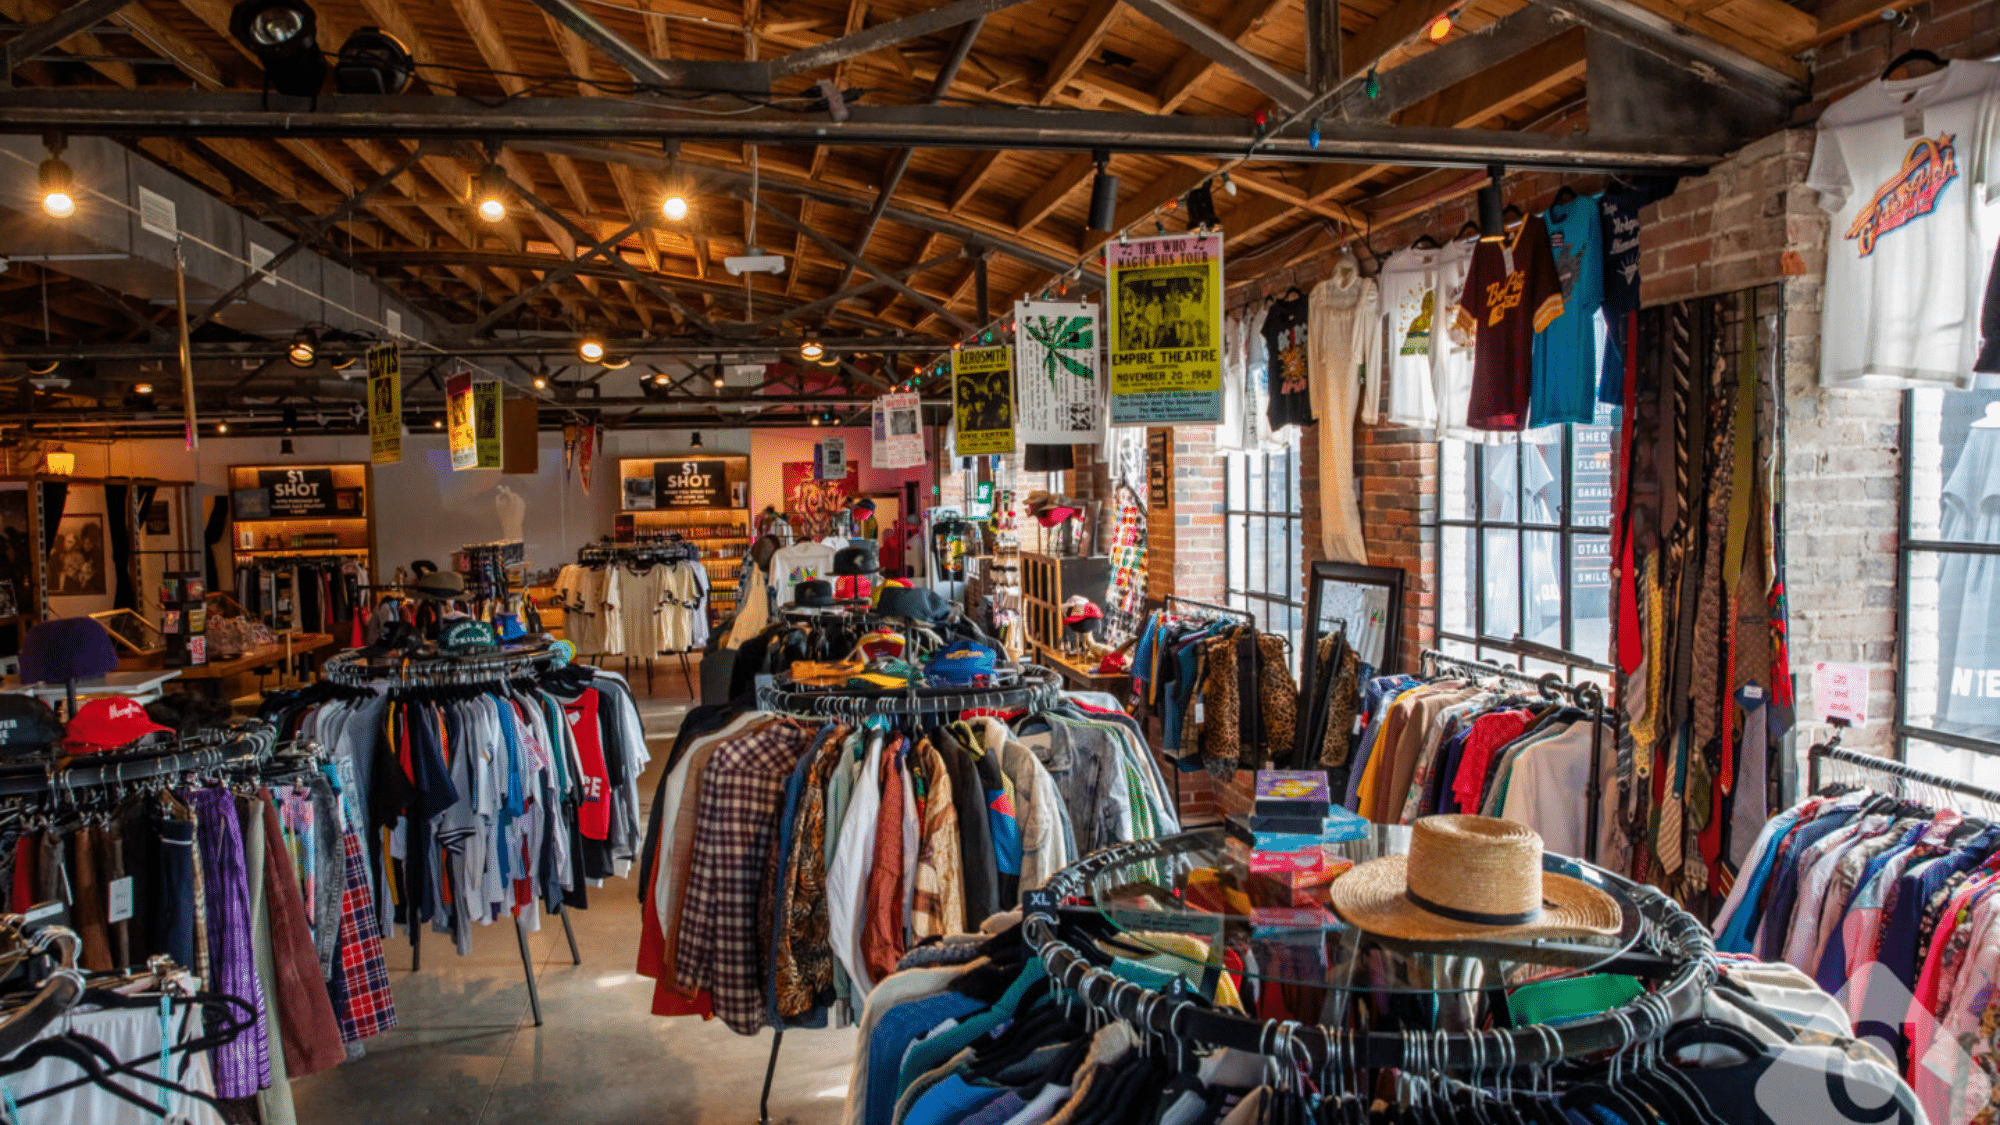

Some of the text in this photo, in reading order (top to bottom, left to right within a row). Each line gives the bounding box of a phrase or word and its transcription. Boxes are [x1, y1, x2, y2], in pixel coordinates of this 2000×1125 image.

[1139, 239, 1187, 254] THE WHO
[1117, 251, 1208, 269] MAGIC BUS TOUR
[959, 349, 1007, 365] AEROSMITH
[1112, 349, 1217, 366] EMPIRE THEATRE
[1116, 371, 1166, 382] NOVEMBER
[1171, 370, 1183, 380] 20
[1191, 369, 1212, 379] 1968
[1577, 431, 1608, 442] SHED
[682, 462, 698, 475] $1
[287, 470, 303, 483] $1
[668, 475, 711, 488] SHOT
[274, 483, 319, 496] SHOT
[1030, 892, 1051, 906] XL
[1173, 978, 1181, 995] S
